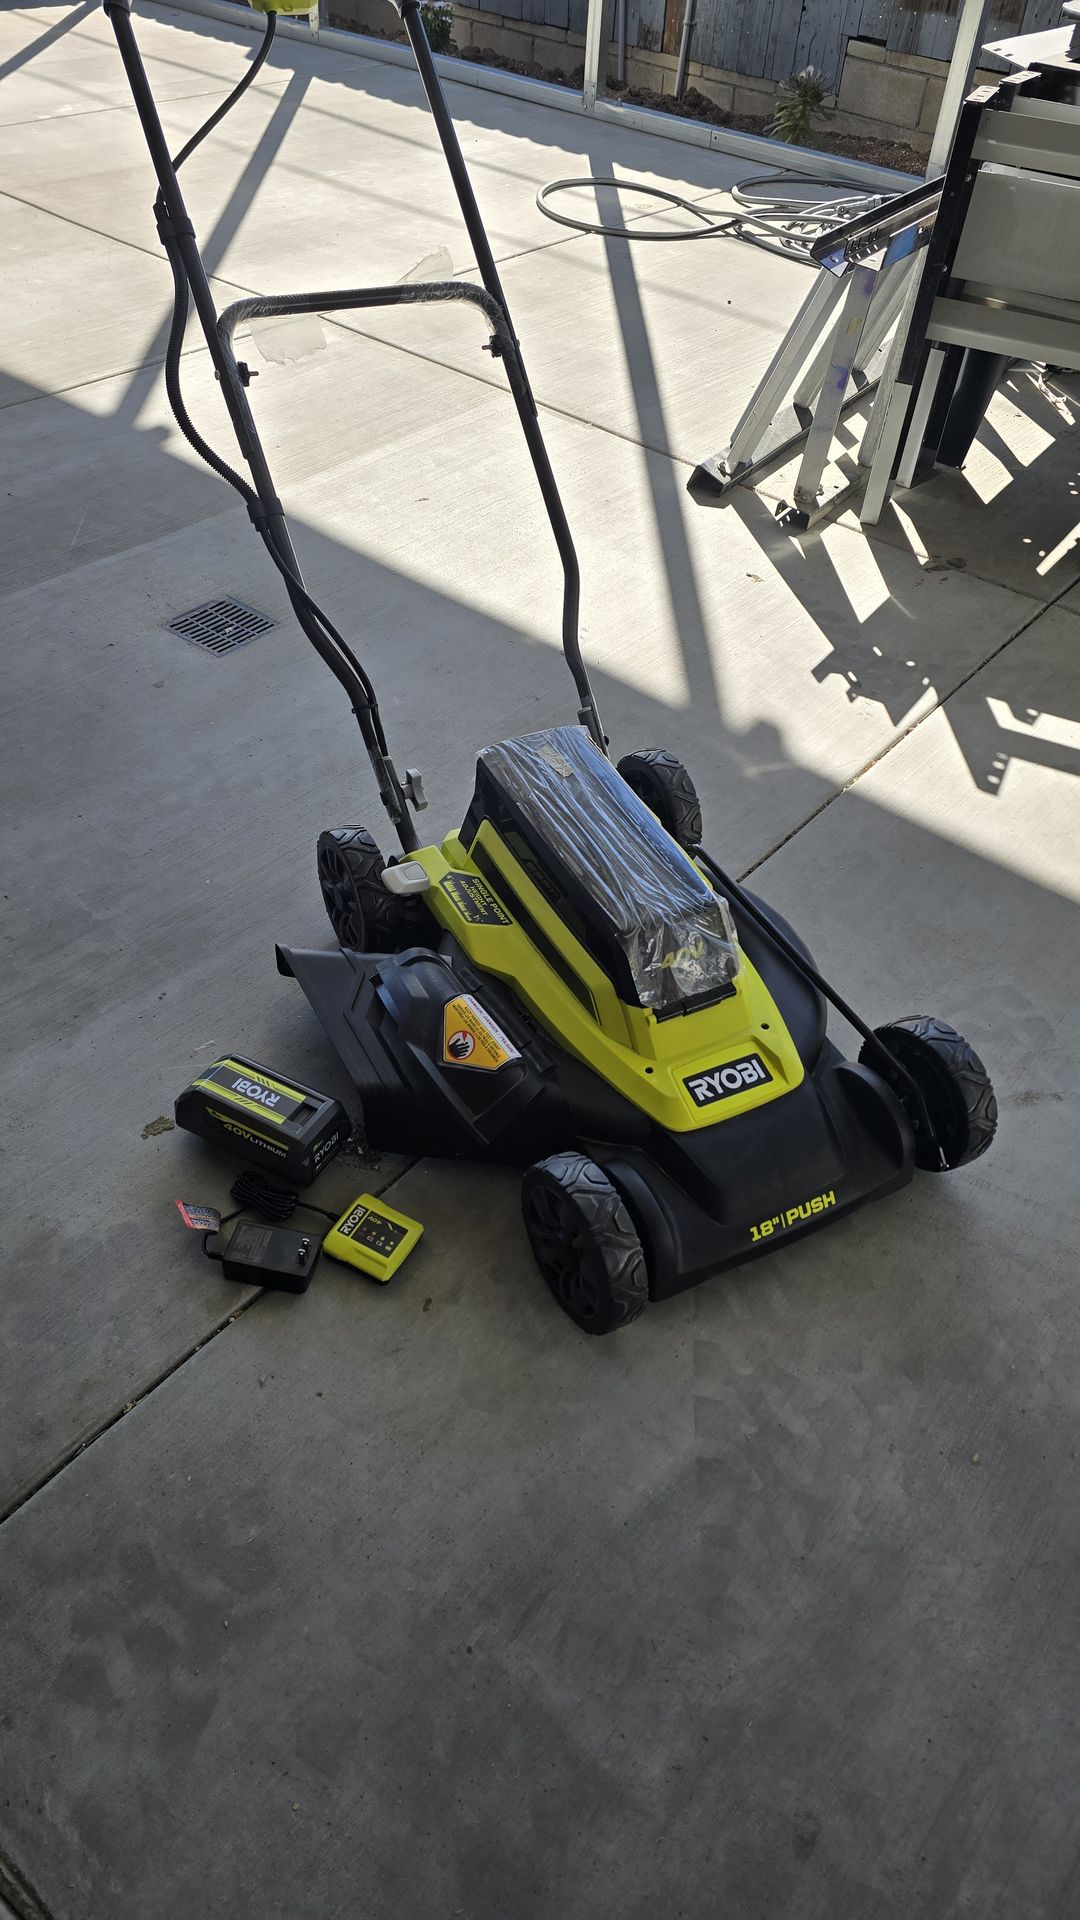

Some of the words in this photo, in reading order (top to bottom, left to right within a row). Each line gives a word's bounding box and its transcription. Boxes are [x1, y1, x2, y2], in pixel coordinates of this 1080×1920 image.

[459, 880, 488, 915] ADJUSTMENT
[469, 885, 487, 906] HEIGHT
[471, 878, 494, 902] SINGLE
[489, 902, 509, 924] POINT
[663, 943, 704, 968] 40V
[231, 1077, 280, 1107] RYOBI
[689, 1059, 766, 1101] RYOBI
[222, 1123, 251, 1139] 40V
[249, 1136, 286, 1158] LITHIUM
[312, 1130, 339, 1163] RYOBI
[340, 1206, 366, 1234] RYOBI
[749, 1215, 781, 1243] 18"
[785, 1190, 836, 1227] PUSH
